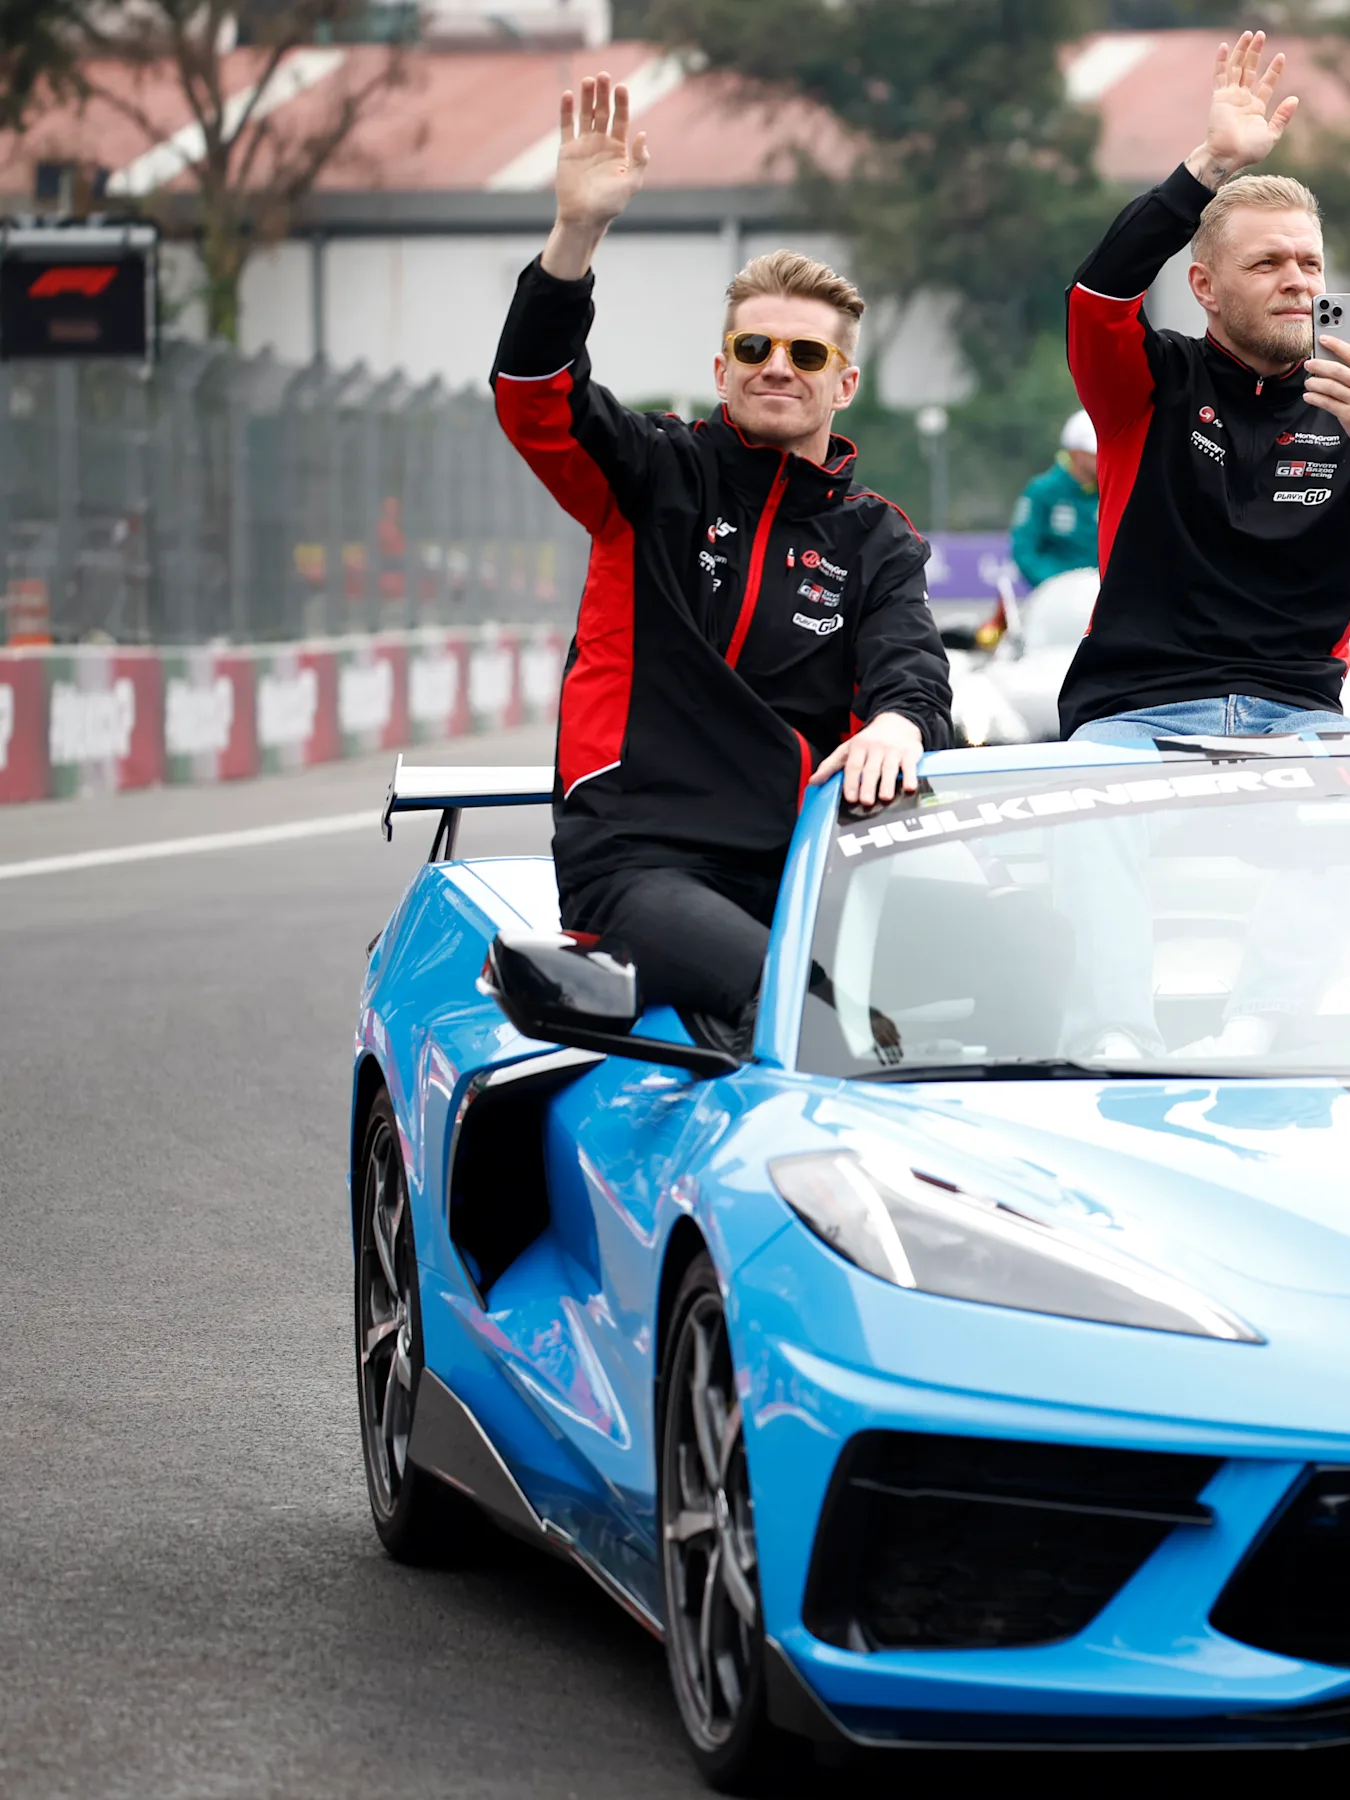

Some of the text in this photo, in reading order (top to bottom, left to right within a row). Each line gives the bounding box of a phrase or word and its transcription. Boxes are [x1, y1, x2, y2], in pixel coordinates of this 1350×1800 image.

[1306, 461, 1338, 469] TOYOTA
[1276, 466, 1303, 476] GR
[1303, 490, 1328, 503] GO
[837, 767, 1316, 857] HÜLKENBERG
